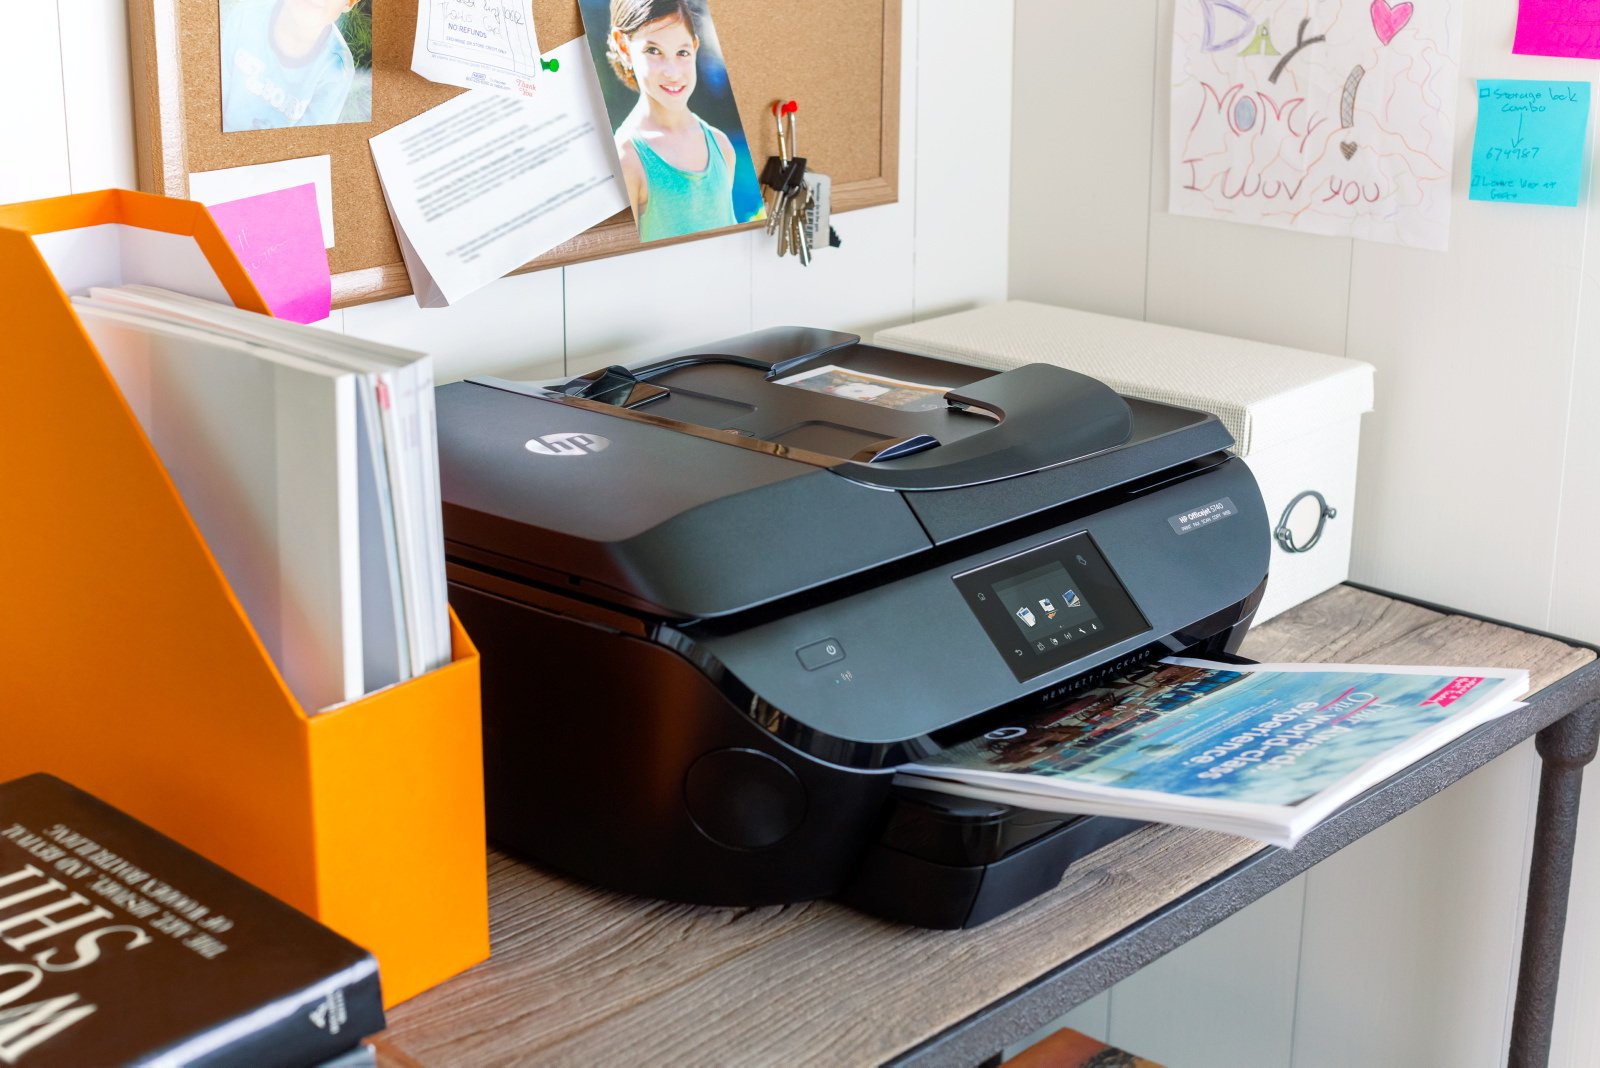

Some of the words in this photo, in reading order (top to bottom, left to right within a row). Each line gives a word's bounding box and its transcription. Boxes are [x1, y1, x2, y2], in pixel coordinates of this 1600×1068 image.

[447, 22, 458, 31] NO
[458, 25, 487, 39] REFUNDS
[515, 78, 537, 91] Thank
[1182, 158, 1205, 192] I
[529, 434, 598, 455] hp
[1178, 515, 1188, 524] HP
[1188, 507, 1212, 520] Officejet
